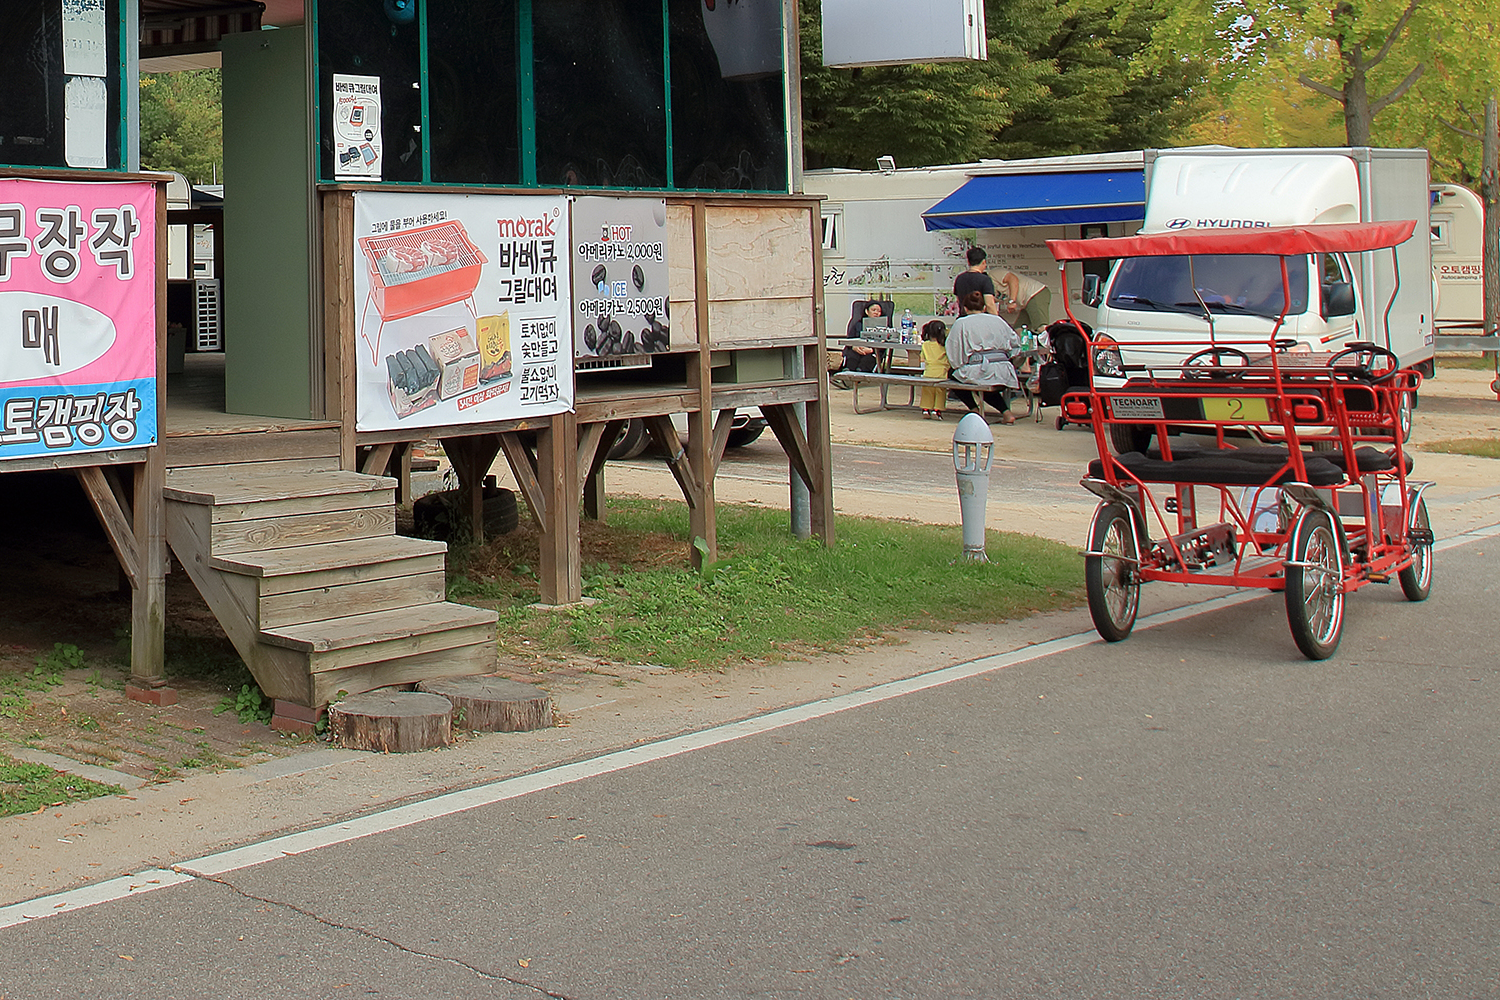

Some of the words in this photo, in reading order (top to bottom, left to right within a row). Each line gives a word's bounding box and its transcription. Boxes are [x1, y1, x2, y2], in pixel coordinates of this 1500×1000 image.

[403, 216, 415, 228] 부어
[497, 213, 556, 237] morak
[1197, 219, 1272, 228] HYUNDAI
[611, 226, 632, 240] HOT
[500, 240, 558, 275] 바베큐
[579, 243, 625, 260] 아메리카노
[627, 243, 663, 261] 2,000원
[1440, 265, 1483, 274] 오토캠핑
[499, 276, 558, 304] 그릴대여
[612, 282, 627, 296] ICE
[580, 300, 625, 317] 아메리카노
[627, 298, 663, 317] 2,500원
[521, 321, 557, 339] 토치없이
[521, 340, 559, 358] 숯만들고
[521, 364, 557, 384] 불쇼없이
[520, 383, 560, 401] 고기먹자
[1112, 398, 1159, 406] TECNOART
[1227, 398, 1245, 420] 2
